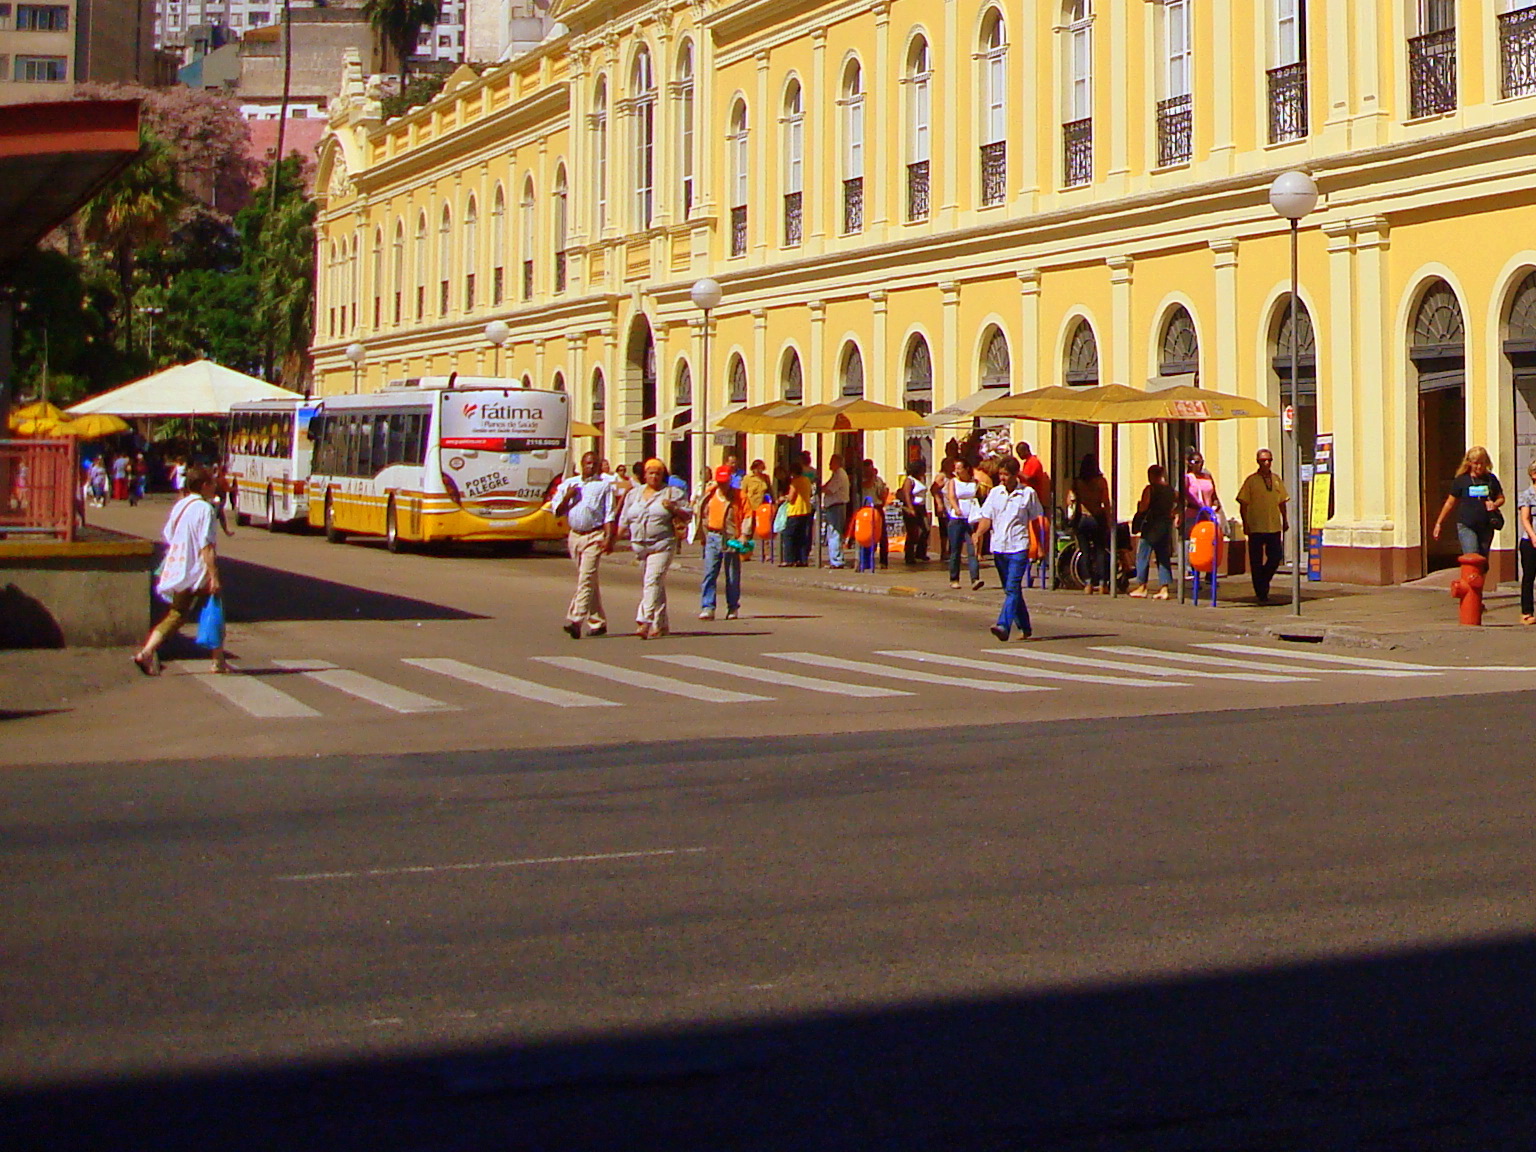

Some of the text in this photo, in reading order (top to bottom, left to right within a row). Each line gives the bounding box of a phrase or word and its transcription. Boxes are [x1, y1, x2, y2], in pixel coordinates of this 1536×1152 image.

[481, 402, 543, 420] fátima
[465, 471, 501, 488] PORTO
[469, 476, 509, 497] ALEGRE
[518, 488, 540, 498] 0314
